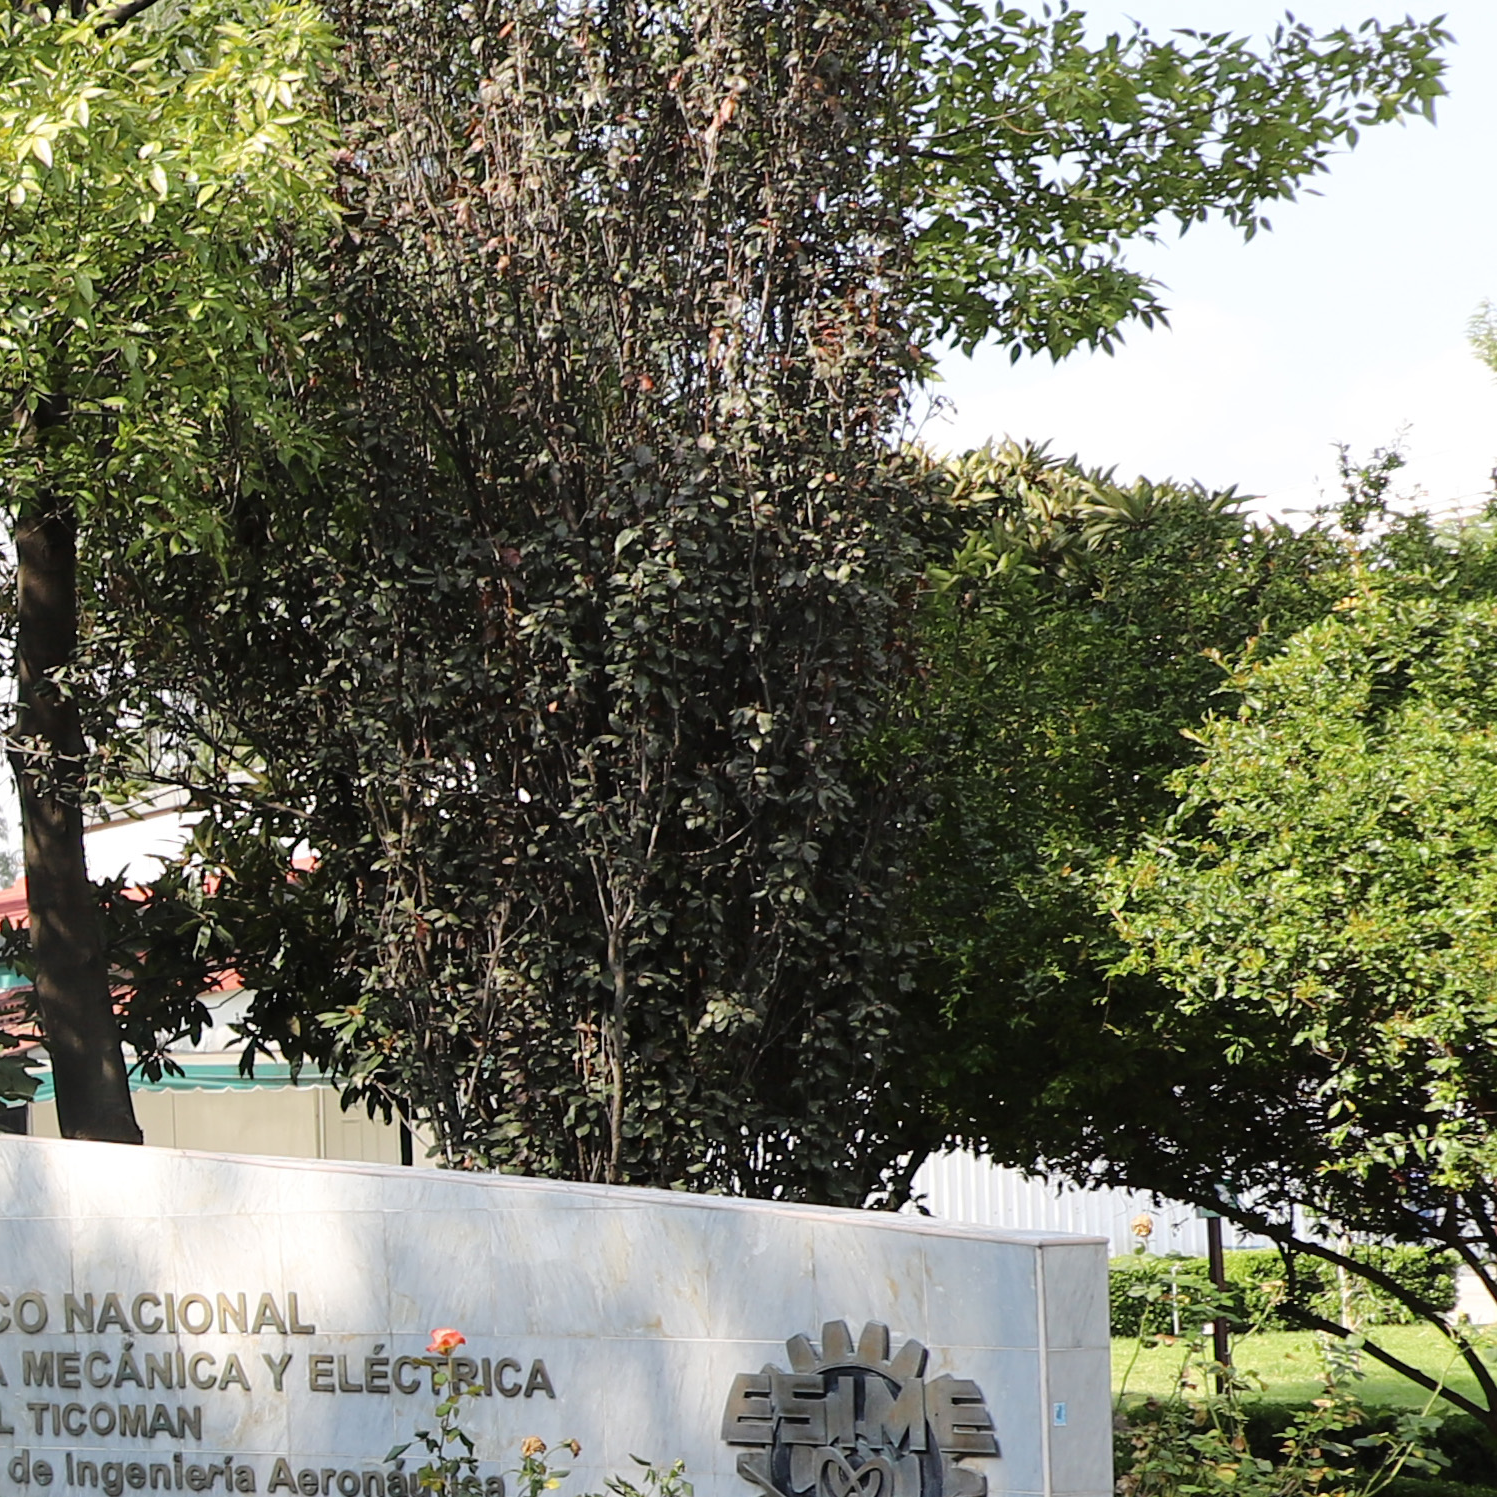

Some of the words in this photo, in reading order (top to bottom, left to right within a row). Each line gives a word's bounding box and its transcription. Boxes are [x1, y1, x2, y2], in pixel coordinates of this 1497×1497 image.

[63, 1292, 315, 1336] NACIONAL
[21, 1343, 251, 1391] MECÁNICA
[262, 1351, 293, 1392] Y
[308, 1343, 556, 1400] ELÉCTRICA
[28, 1402, 203, 1441] TICOMAN
[8, 1449, 53, 1486] de
